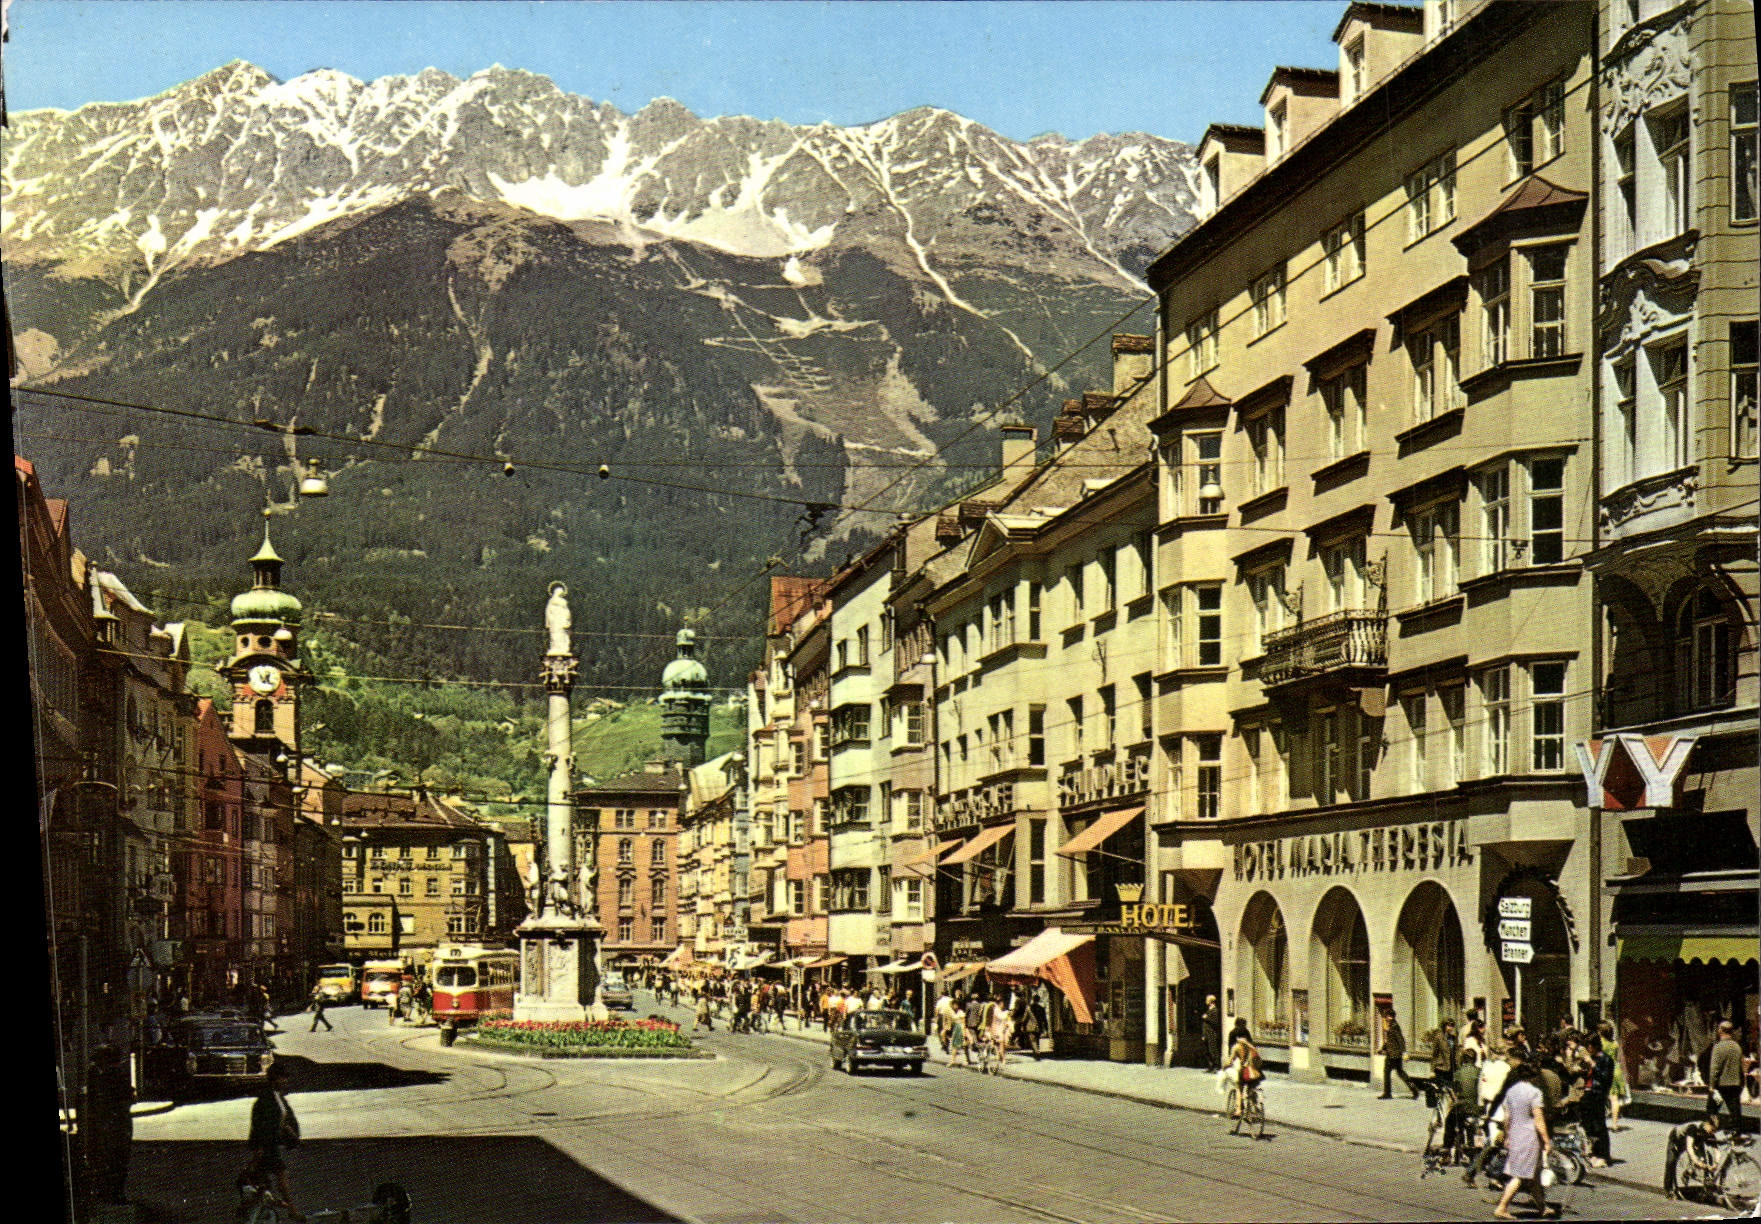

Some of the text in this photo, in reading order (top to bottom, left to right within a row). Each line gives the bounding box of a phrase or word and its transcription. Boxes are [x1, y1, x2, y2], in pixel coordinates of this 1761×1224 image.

[1233, 819, 1473, 876] HOTEL MARIA THERESIA
[1501, 899, 1530, 918] Salzburg
[1504, 943, 1528, 959] Brenner
